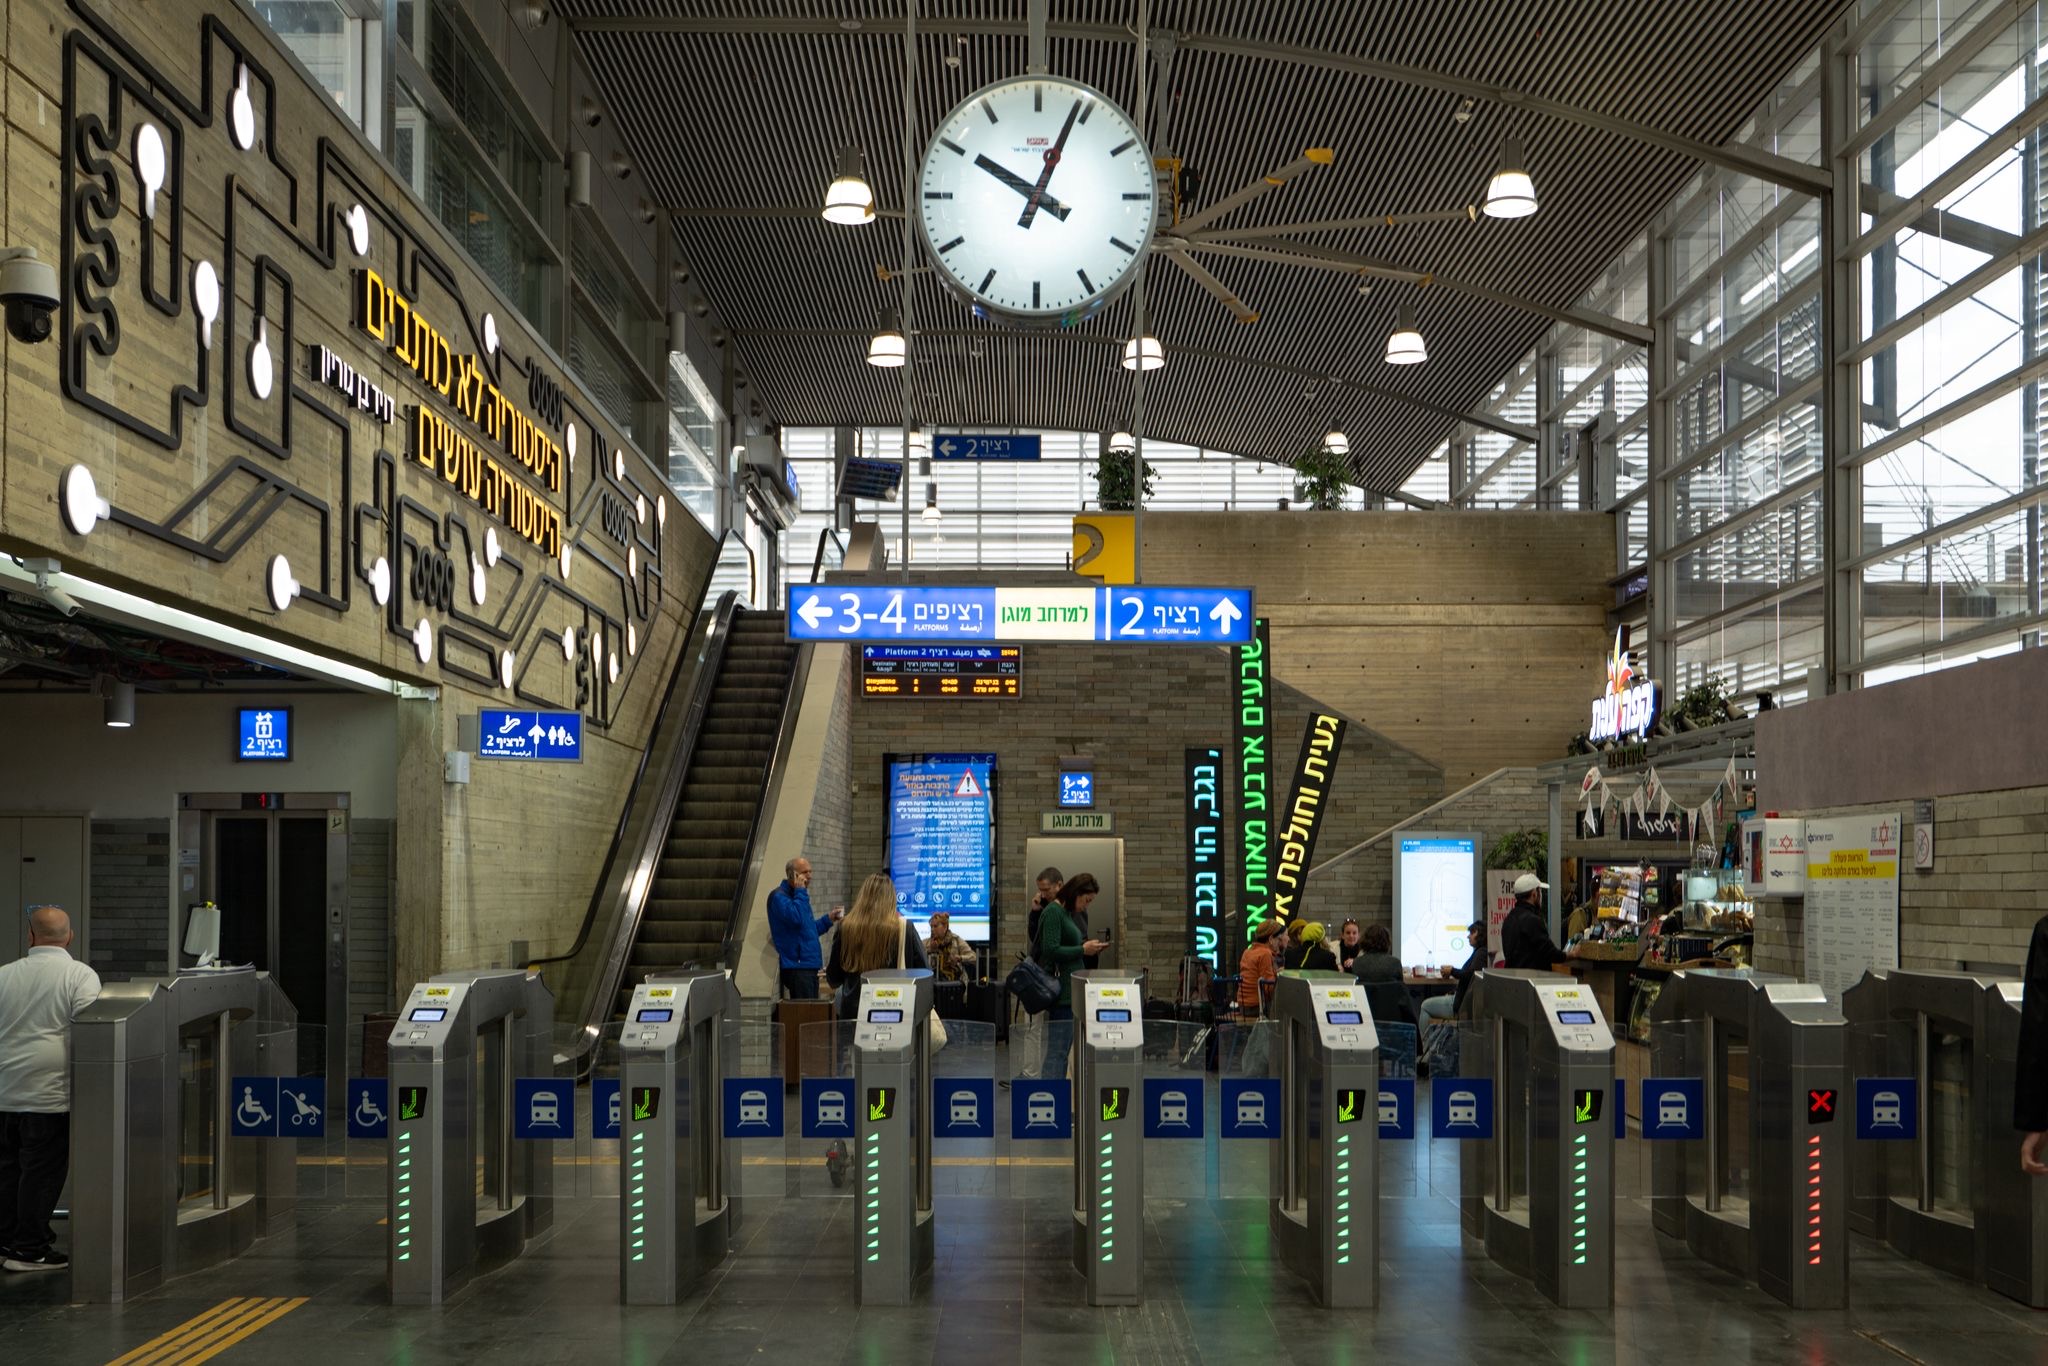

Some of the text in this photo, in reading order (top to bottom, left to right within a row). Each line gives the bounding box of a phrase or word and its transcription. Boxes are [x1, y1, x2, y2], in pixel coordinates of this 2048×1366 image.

[321, 344, 395, 426] דויד בן גוריון
[367, 268, 562, 493] היסטוריה לא כותבים
[966, 439, 1010, 457] רציף 2
[419, 404, 561, 559] היסטוריה עושים
[838, 592, 983, 634] רציפים 3-4
[913, 624, 949, 632] PLATFORMS
[1001, 605, 1089, 623] למרחב מוגן
[1119, 596, 1200, 635] רציף 2
[884, 647, 927, 656] Platform 2
[929, 648, 949, 657] רציף
[952, 648, 974, 658] رصيف
[1241, 637, 1264, 726] שבעים
[1620, 682, 1653, 738] קפה
[246, 737, 282, 751] רציף 2
[486, 735, 526, 749] לרציף 2
[1304, 713, 1339, 784] געית
[1243, 735, 1266, 811] ארבע
[1063, 789, 1090, 801] רציף 2
[1053, 815, 1103, 828] מרחב מוגן
[1276, 786, 1320, 889] וחולפת
[1194, 826, 1216, 862] הוי
[1245, 820, 1268, 896] מאות
[1195, 872, 1217, 917] נגב
